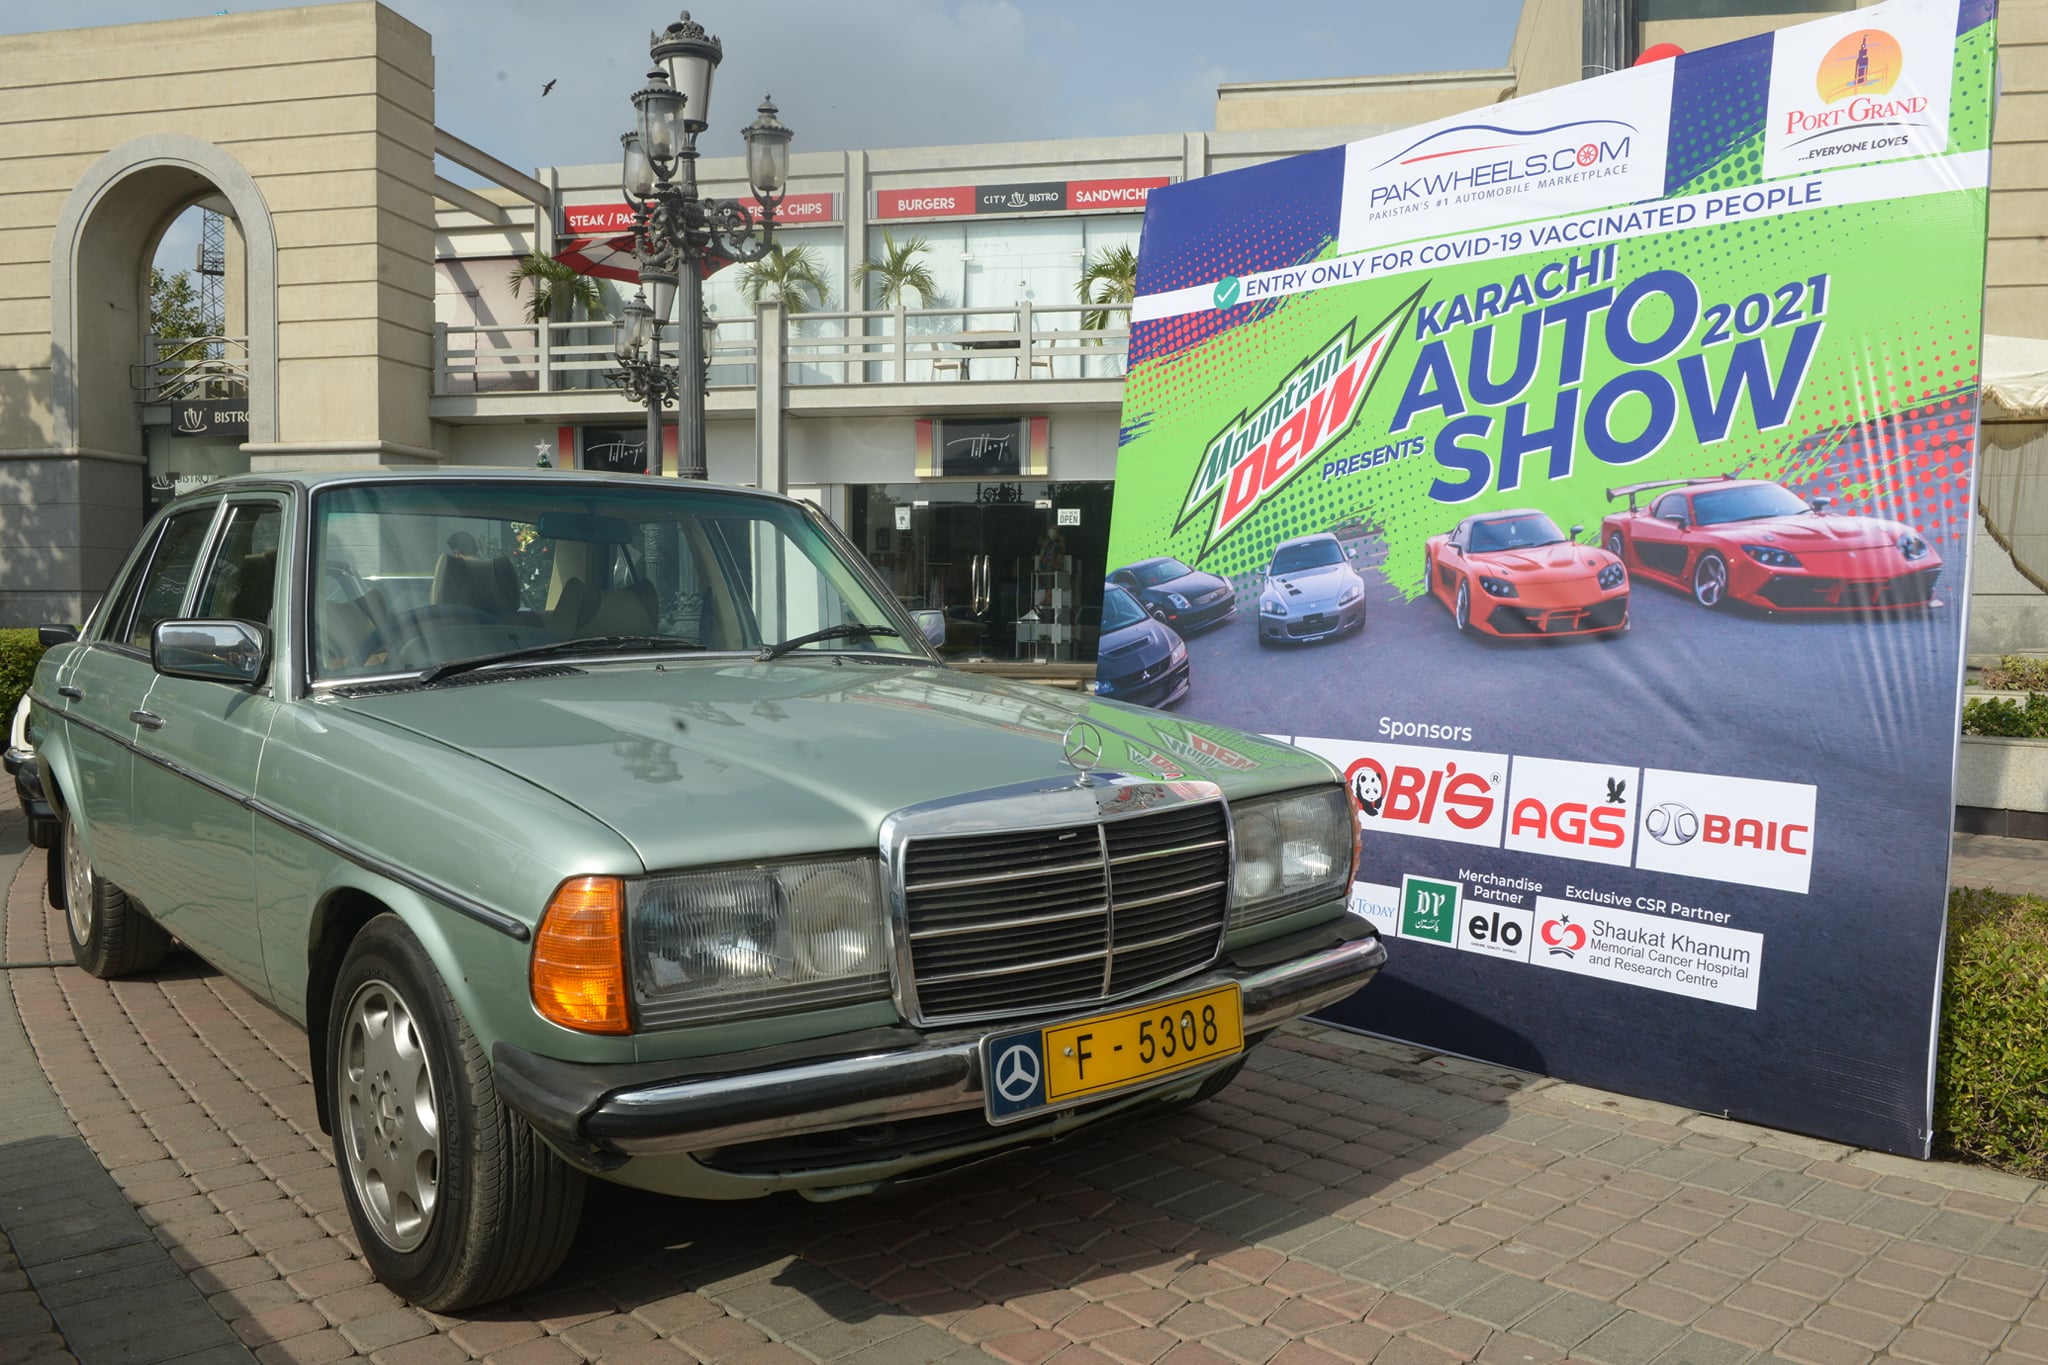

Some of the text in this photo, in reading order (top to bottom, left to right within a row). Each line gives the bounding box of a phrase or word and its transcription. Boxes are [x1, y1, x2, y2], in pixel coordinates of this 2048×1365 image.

[1871, 135, 1909, 149] LOVES
[1368, 163, 1629, 222] PAKISTAN'S #1 AUTOMOBILE MARKETPLACE
[1369, 136, 1631, 208] PAKWHEELS.COM
[748, 203, 822, 217] FIS & CHIPS
[897, 197, 956, 212] BURGERS
[983, 192, 1059, 204] CITY BISTRO
[1076, 187, 1157, 203] SANDWICH
[569, 214, 605, 226] STEAK
[1245, 181, 1822, 297] ENTRY ONLY FOR COVID-19 VACCINATED PEOPLE
[1415, 243, 1619, 342] KARACHI
[1700, 272, 1831, 348] 2021
[1387, 269, 1702, 434] AUTO
[1191, 342, 1343, 504] Mountain
[1428, 320, 1826, 503] SHOW
[1322, 436, 1425, 481] PRESENTS
[1060, 515, 1078, 524] OPEN
[1378, 717, 1473, 742] Sponsors
[1344, 757, 1494, 830] OBI'S
[1511, 797, 1626, 848] AGS
[1702, 814, 1808, 856] BAIC
[1458, 868, 1544, 893] Merchandise
[1473, 885, 1524, 904] Partner
[1565, 885, 1731, 924] Exclusive CSR Partner
[1468, 912, 1522, 946] elo
[1592, 919, 1750, 963] Shaukat Khanum
[1588, 953, 1718, 988] and Research Centre
[1590, 938, 1749, 979] Memorial Cancer Hospital
[1139, 1005, 1218, 1064] 5308
